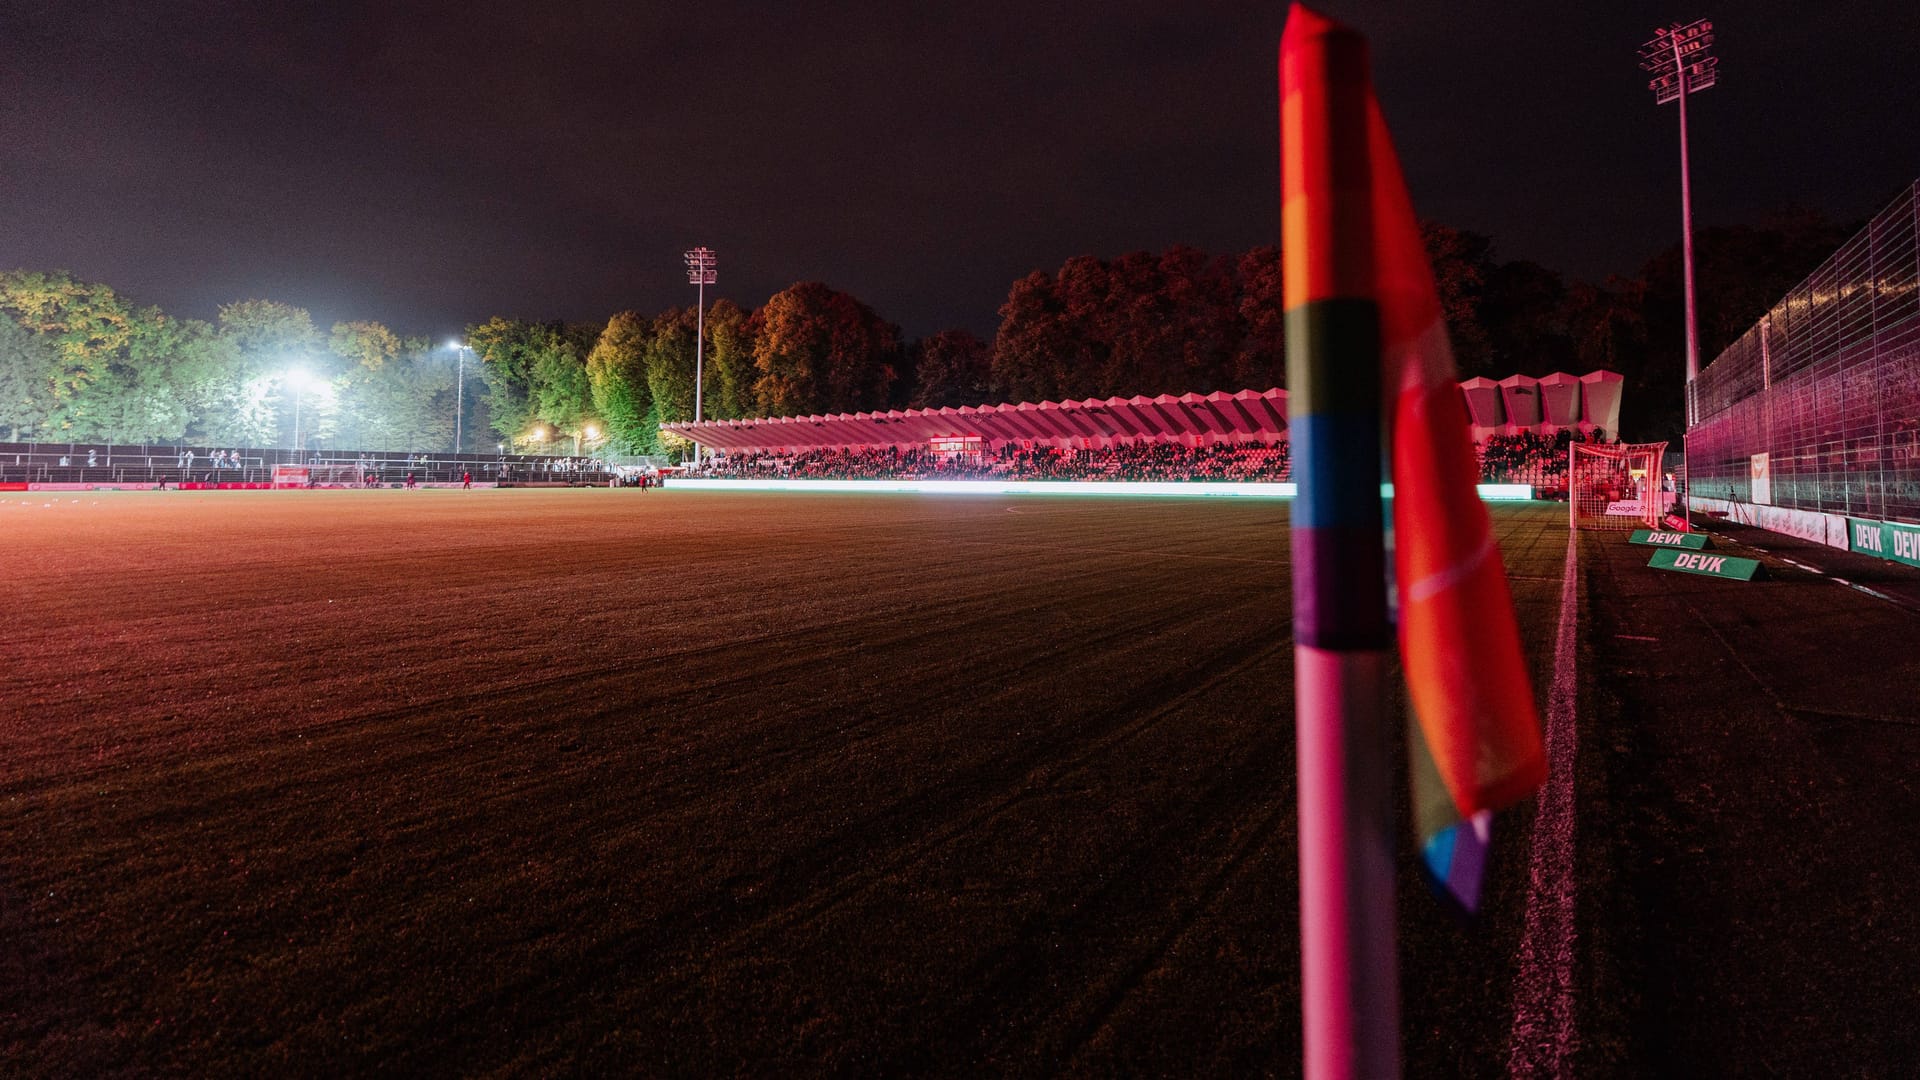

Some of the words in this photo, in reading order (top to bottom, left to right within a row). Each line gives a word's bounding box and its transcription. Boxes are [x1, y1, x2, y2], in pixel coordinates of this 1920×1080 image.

[1609, 504, 1637, 513] Google
[1646, 532, 1685, 545] DEVK
[1855, 524, 1883, 553] DEVK
[1893, 530, 1920, 561] DEV
[1673, 553, 1727, 573] DEVK
